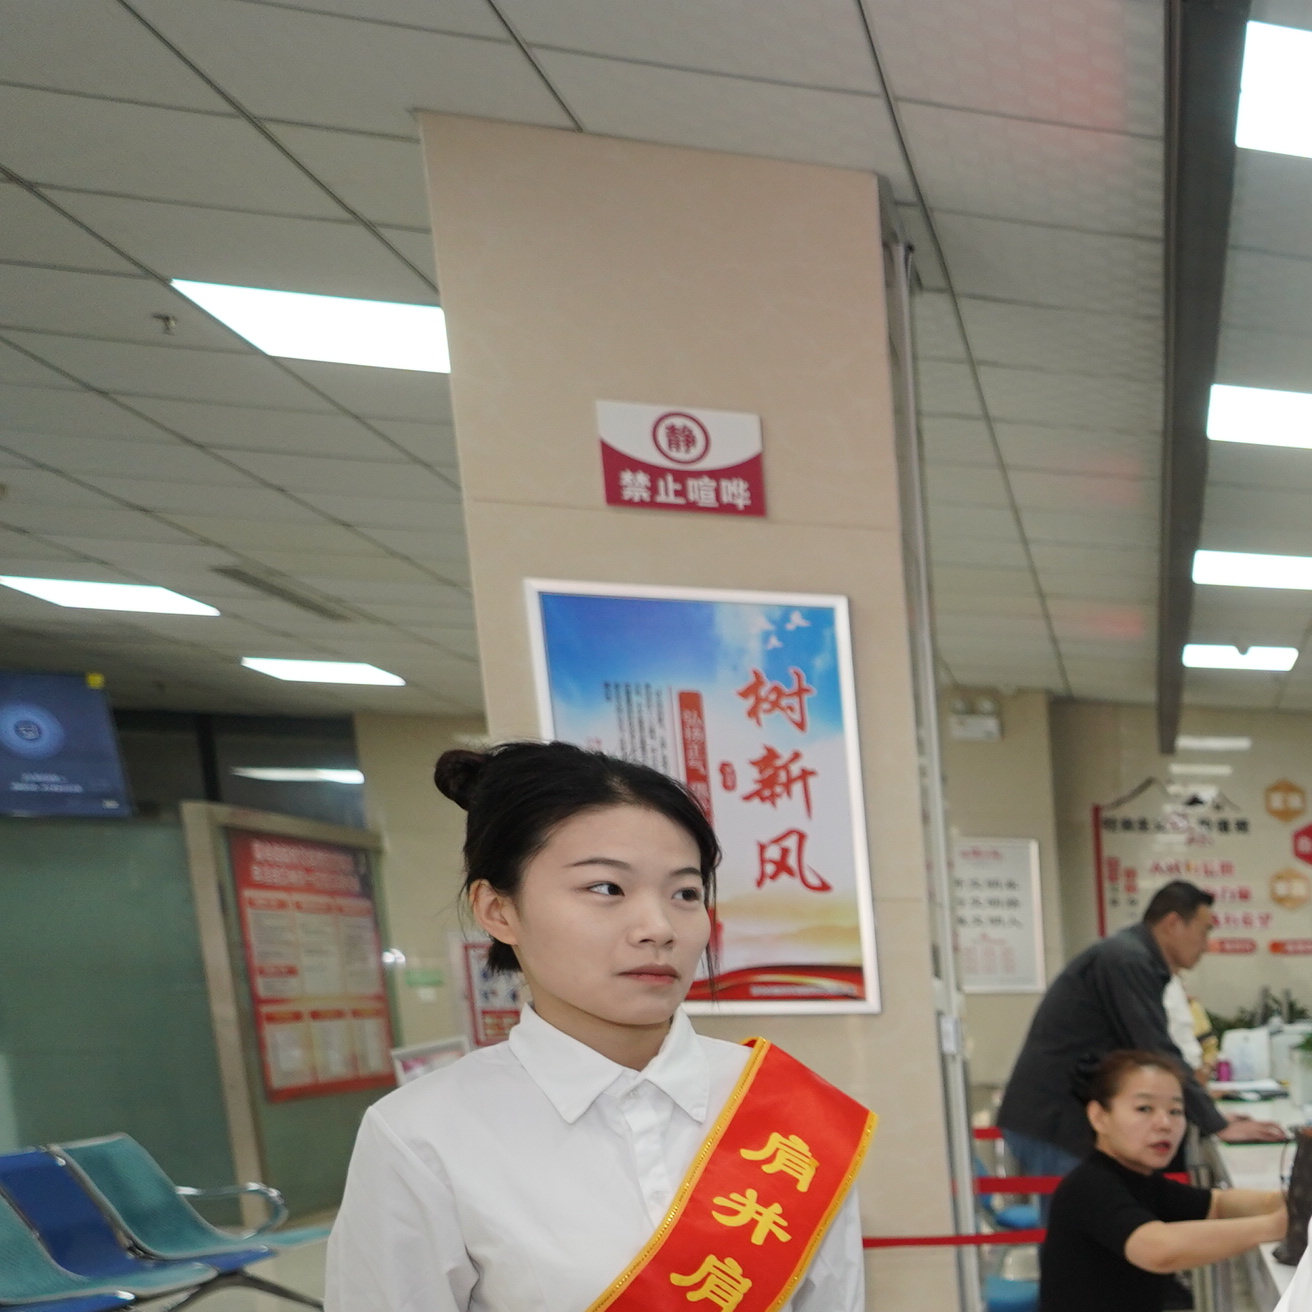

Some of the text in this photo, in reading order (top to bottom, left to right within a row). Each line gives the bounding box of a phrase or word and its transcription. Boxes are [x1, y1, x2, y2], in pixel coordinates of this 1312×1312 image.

[665, 424, 697, 454] 静
[619, 468, 752, 511] 禁止喧哗
[736, 665, 833, 895] 树新风
